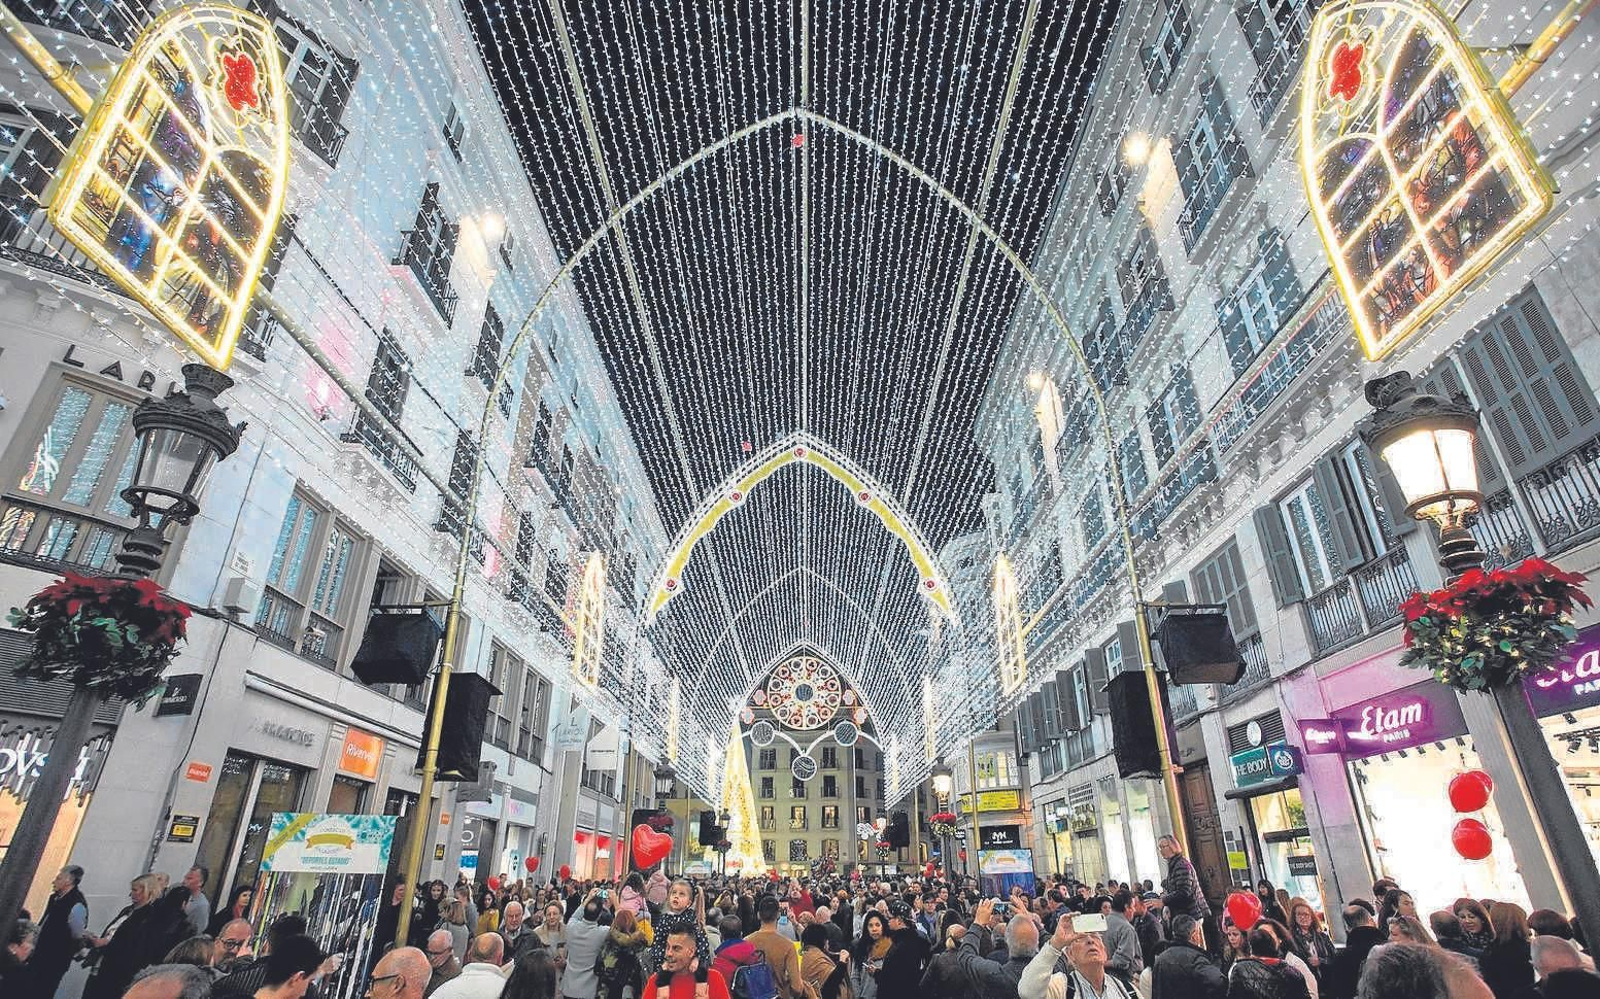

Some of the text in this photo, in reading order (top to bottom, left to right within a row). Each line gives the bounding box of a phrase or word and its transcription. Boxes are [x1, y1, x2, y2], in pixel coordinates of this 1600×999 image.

[1360, 703, 1422, 735] Etam
[1383, 729, 1411, 742] PARIS
[1247, 758, 1268, 774] BODY
